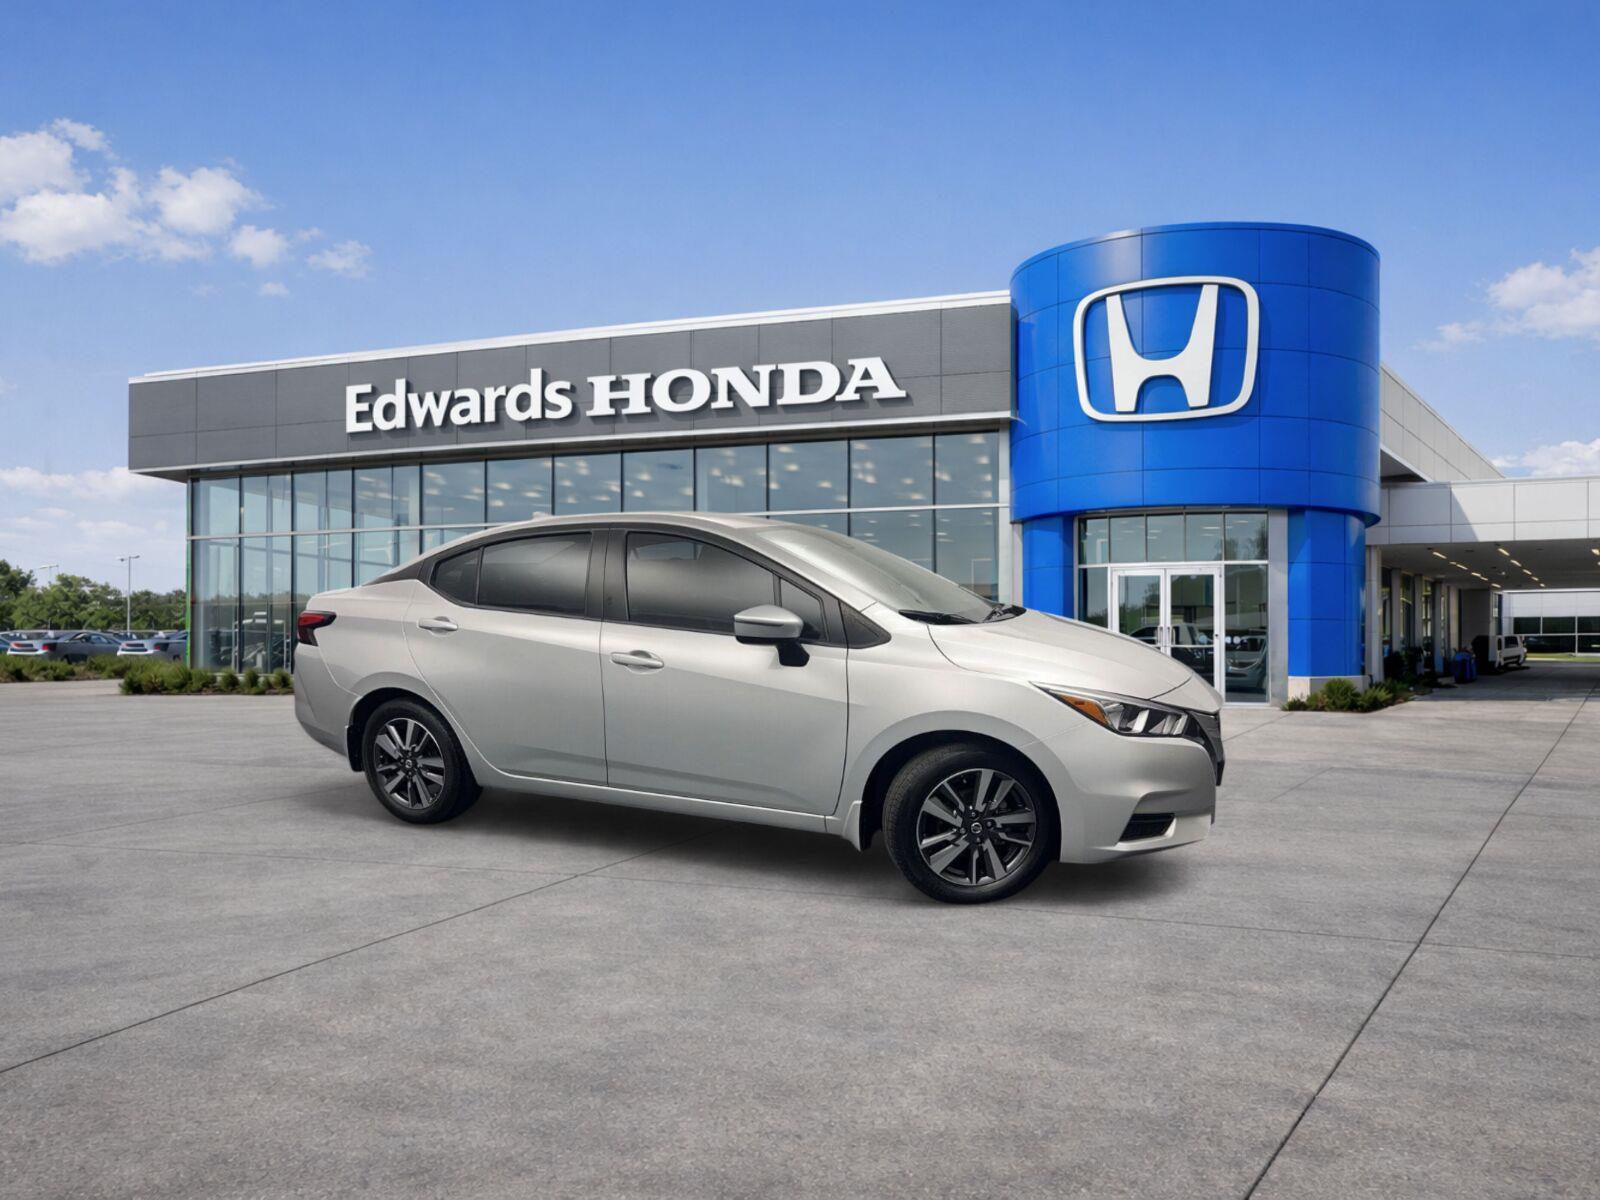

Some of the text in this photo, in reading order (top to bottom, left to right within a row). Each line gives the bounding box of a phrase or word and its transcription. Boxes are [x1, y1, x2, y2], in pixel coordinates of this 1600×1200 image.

[345, 356, 907, 434] Edwards HONDA
[1105, 283, 1220, 413] H
